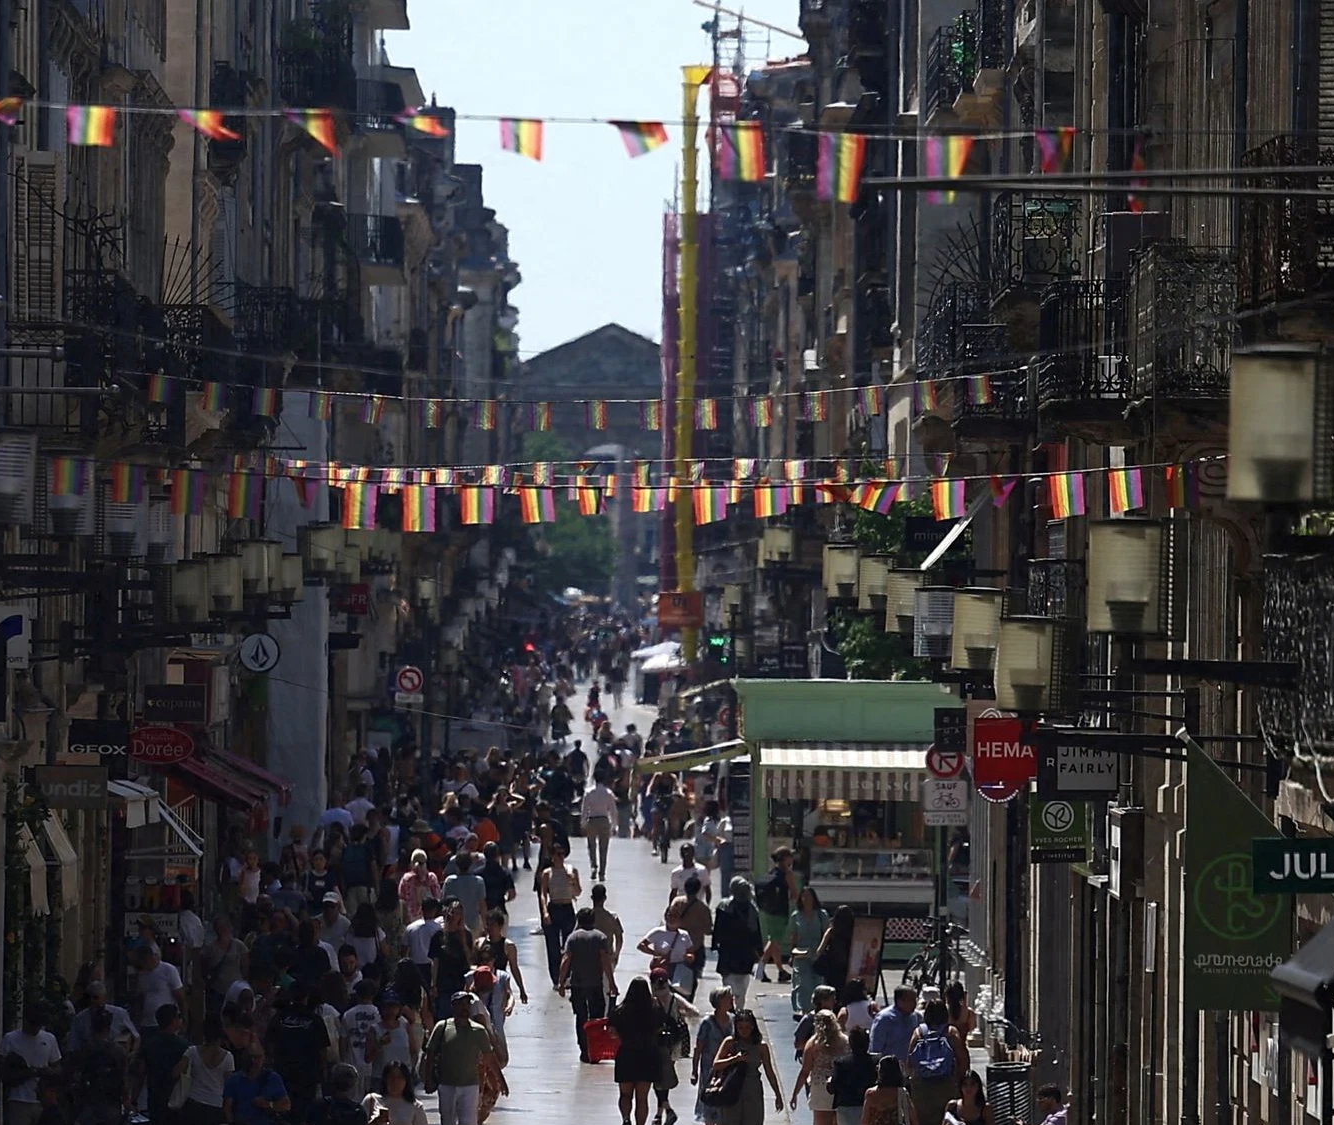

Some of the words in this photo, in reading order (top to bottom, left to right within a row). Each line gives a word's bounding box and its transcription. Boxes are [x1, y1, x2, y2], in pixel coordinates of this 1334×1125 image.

[70, 743, 127, 755] GEOX
[133, 739, 184, 757] Dorée
[977, 742, 1034, 758] HEMA
[1060, 763, 1114, 773] FAIRLY
[41, 778, 102, 798] undiz
[935, 782, 958, 790] SAUF
[1194, 952, 1283, 969] promenade
